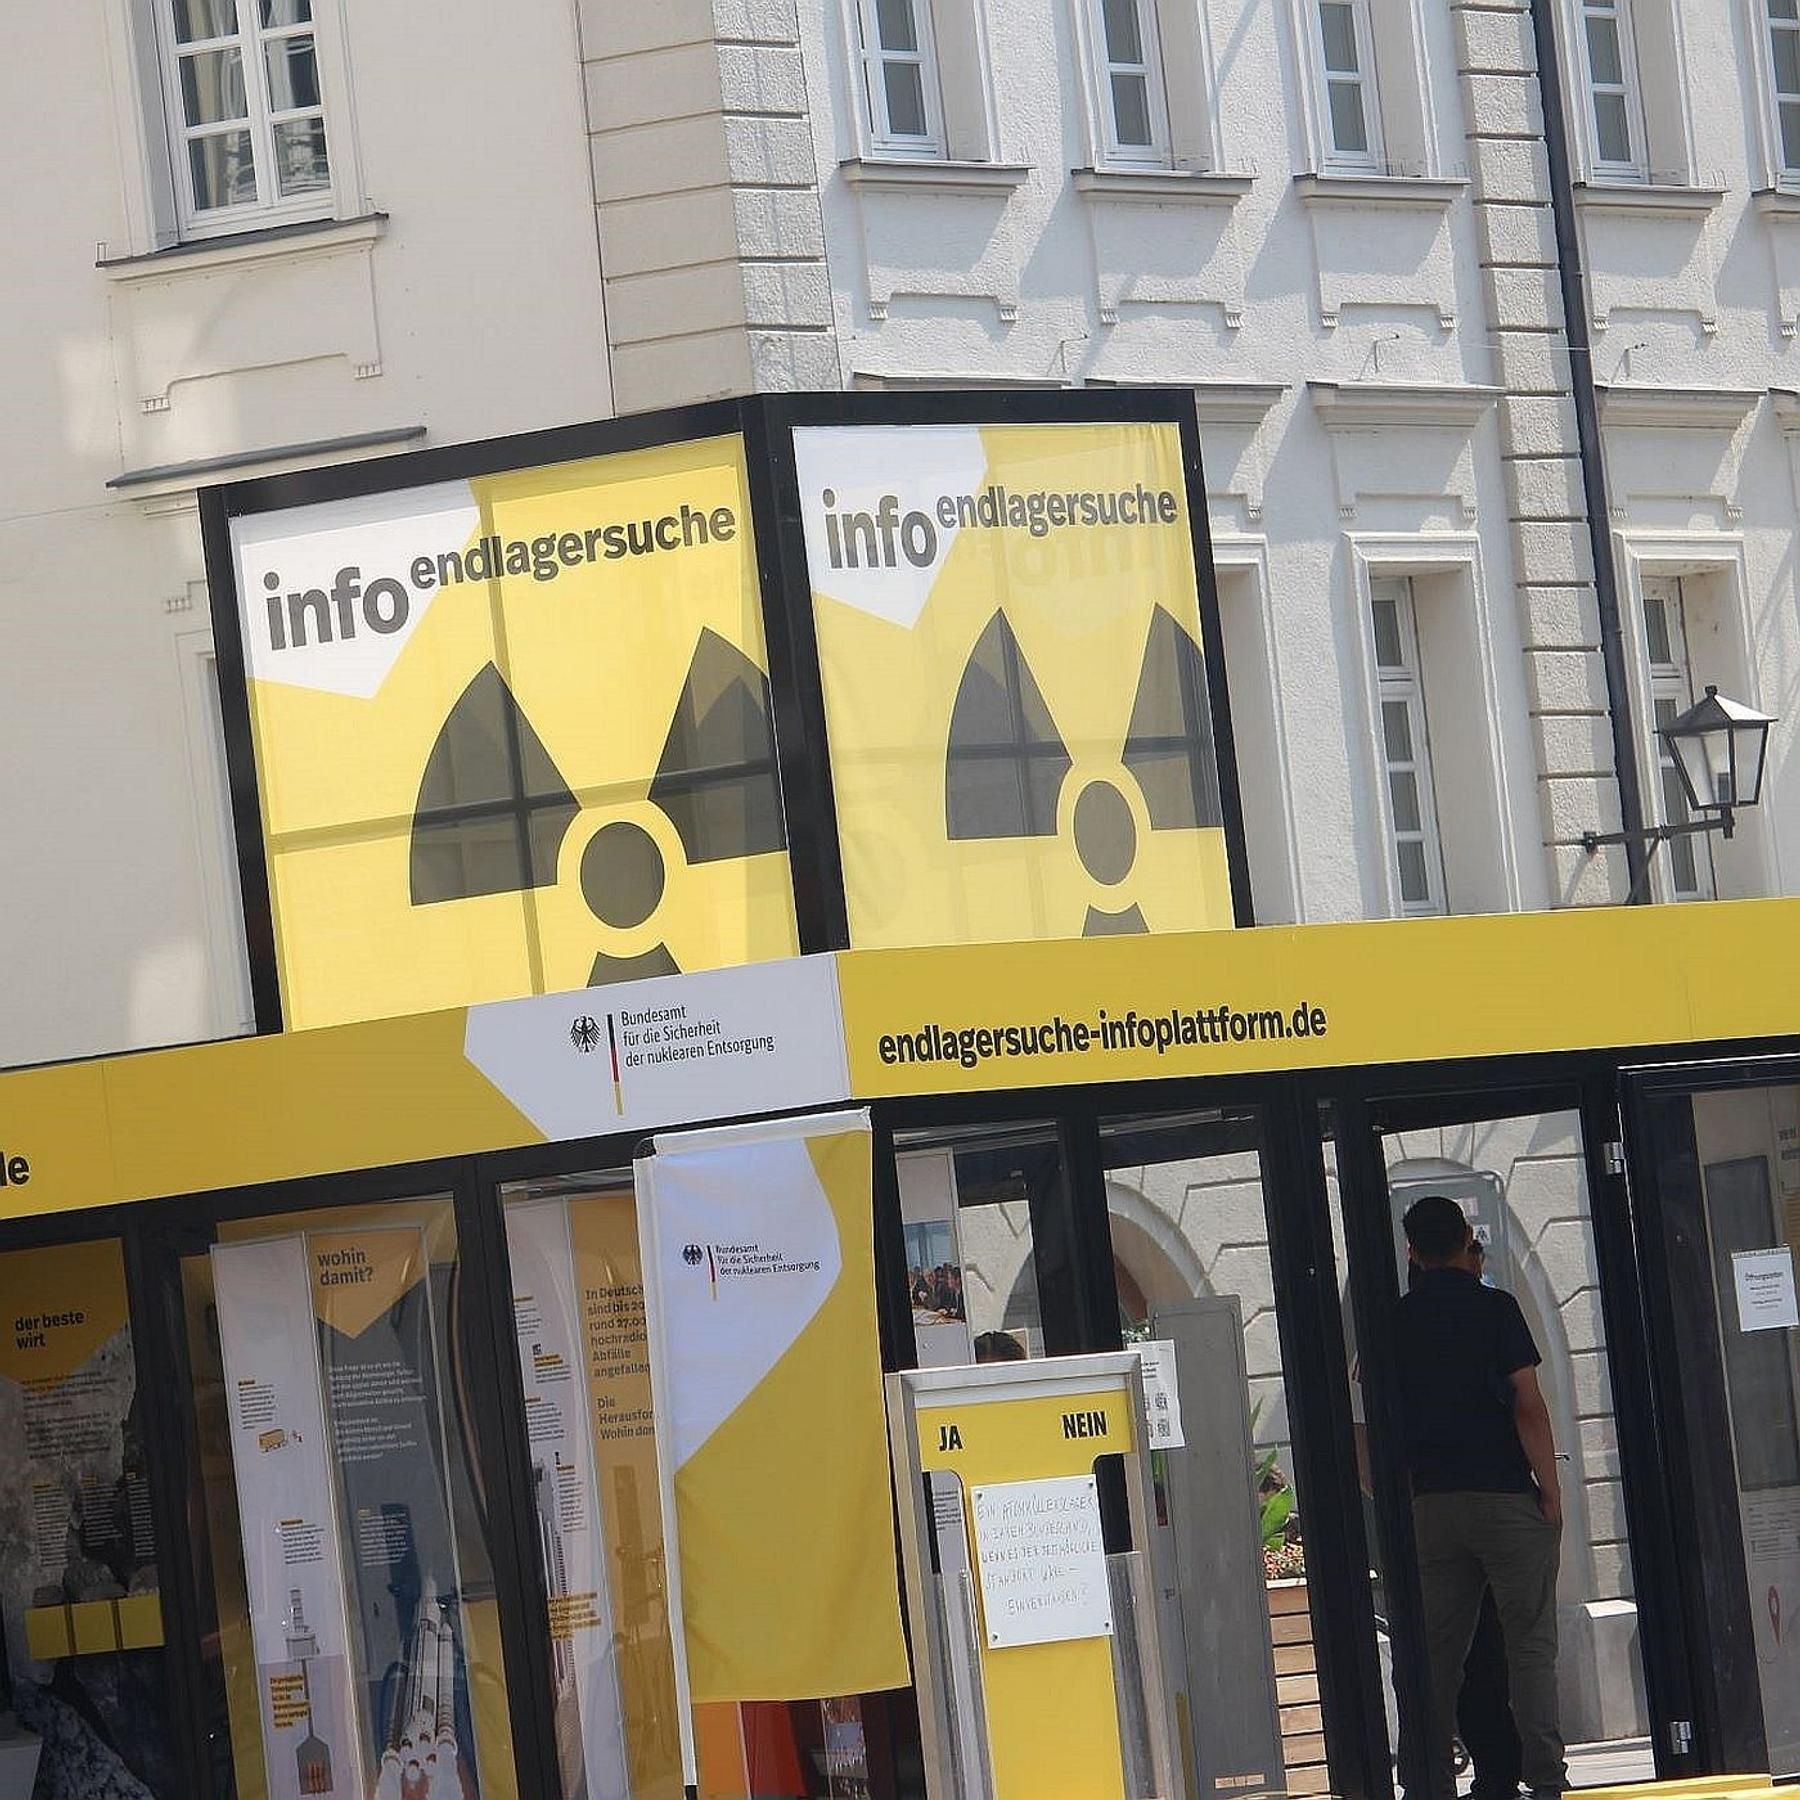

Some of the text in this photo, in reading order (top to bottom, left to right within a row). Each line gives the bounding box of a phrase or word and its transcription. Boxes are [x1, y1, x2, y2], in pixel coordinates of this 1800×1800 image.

[825, 485, 1178, 571] info endlagersuche
[264, 501, 735, 650] info endlagersuche
[621, 1006, 687, 1027] Bundesamt
[623, 1020, 721, 1047] für die Sicherheit
[879, 1003, 1327, 1068] endlagersuche-infoplattform.de
[625, 1036, 774, 1067] der nuklearen Entsorgung
[317, 1247, 366, 1268] wohin
[320, 1266, 373, 1287] damit?
[585, 1290, 598, 1301] In
[587, 1303, 610, 1317] sind
[613, 1301, 630, 1315] bis
[15, 1310, 84, 1333] der beste
[590, 1317, 614, 1331] rund
[16, 1332, 46, 1350] wirt
[593, 1349, 631, 1362] Abfälle
[597, 1395, 616, 1409] Die
[600, 1427, 634, 1440] Wohin
[1062, 1411, 1108, 1440] NEIN
[939, 1425, 963, 1451] JA
